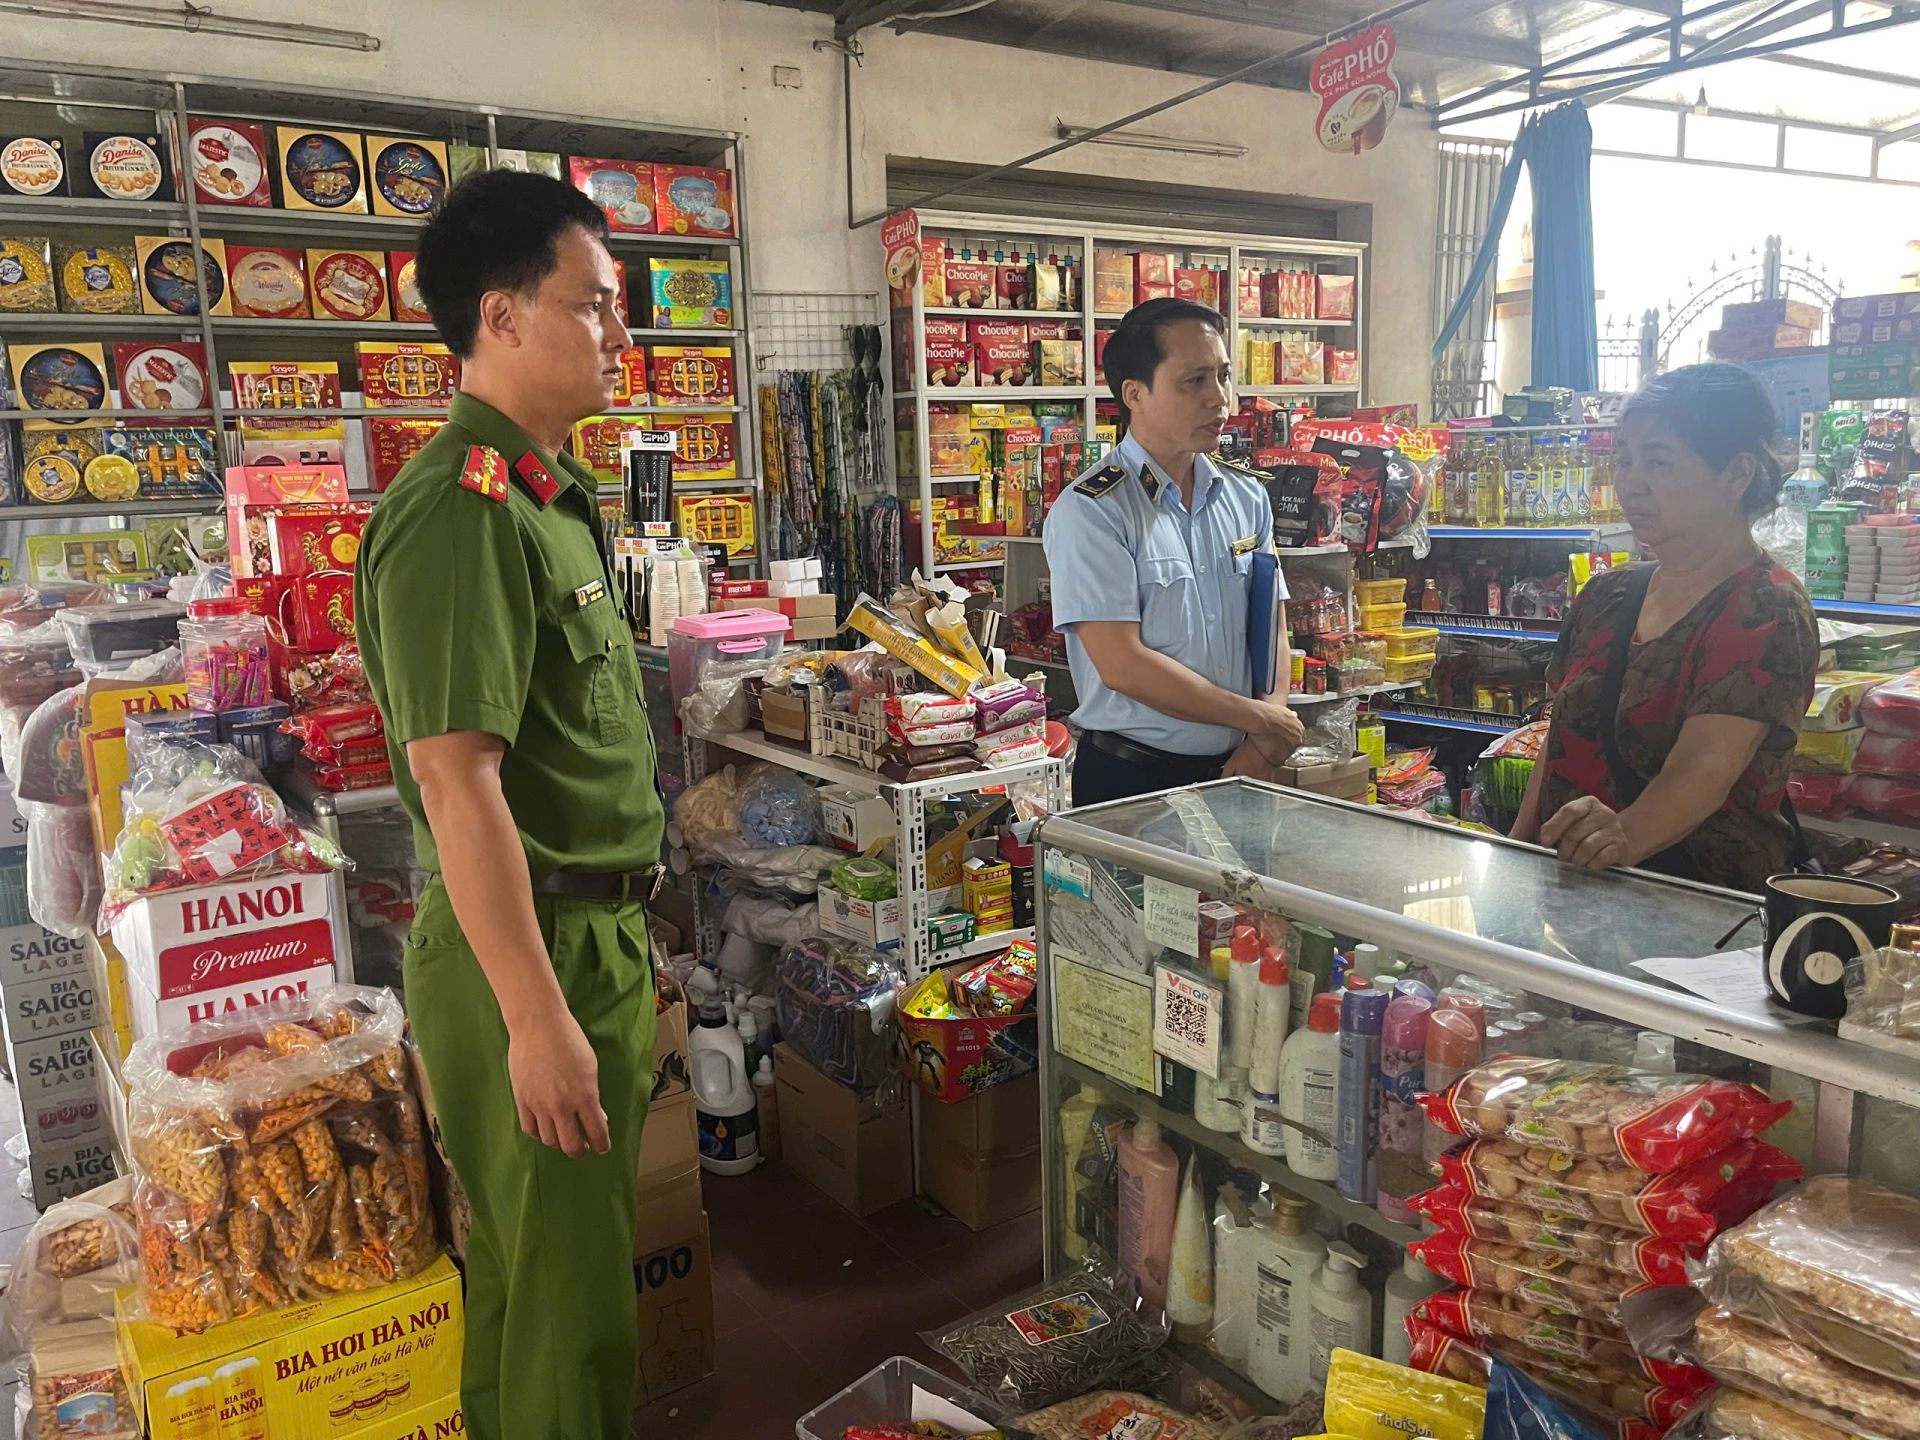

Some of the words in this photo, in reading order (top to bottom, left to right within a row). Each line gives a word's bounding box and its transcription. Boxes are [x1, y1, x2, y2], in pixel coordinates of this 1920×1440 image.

[1344, 28, 1389, 79] PHỐ
[9, 146, 49, 162] Danisa
[101, 149, 145, 165] Danisa
[947, 269, 988, 281] ChocoPie
[1005, 272, 1028, 283] Choc
[925, 324, 958, 335] hocoPie
[978, 325, 1019, 336] ChocoPie
[927, 347, 965, 358] hocoPie
[989, 348, 1030, 359] ChocoPie
[1007, 433, 1041, 443] ChocoPie
[728, 585, 751, 594] maxell
[181, 882, 305, 934] HANOI
[23, 952, 84, 975] LAGE
[191, 938, 307, 981] Premium
[51, 980, 80, 994] BIA
[19, 989, 93, 1019] SAIGO
[32, 1008, 92, 1031] LAGE
[60, 1036, 90, 1052] BIA
[75, 1145, 104, 1161] BIA
[274, 1350, 317, 1382] BIA
[320, 1331, 366, 1365] HƠI
[371, 1316, 405, 1348] HÀ
[409, 1300, 451, 1333] NỘI
[296, 1375, 321, 1395] Một
[323, 1367, 343, 1384] nét
[346, 1361, 367, 1377] văn
[370, 1351, 391, 1368] hóa
[395, 1342, 412, 1360] Hà
[415, 1333, 436, 1351] Nội
[224, 1394, 239, 1405] BIA
[220, 1405, 239, 1421] HÀ
[240, 1397, 264, 1414] NỘI
[434, 1410, 465, 1440] NỘ
